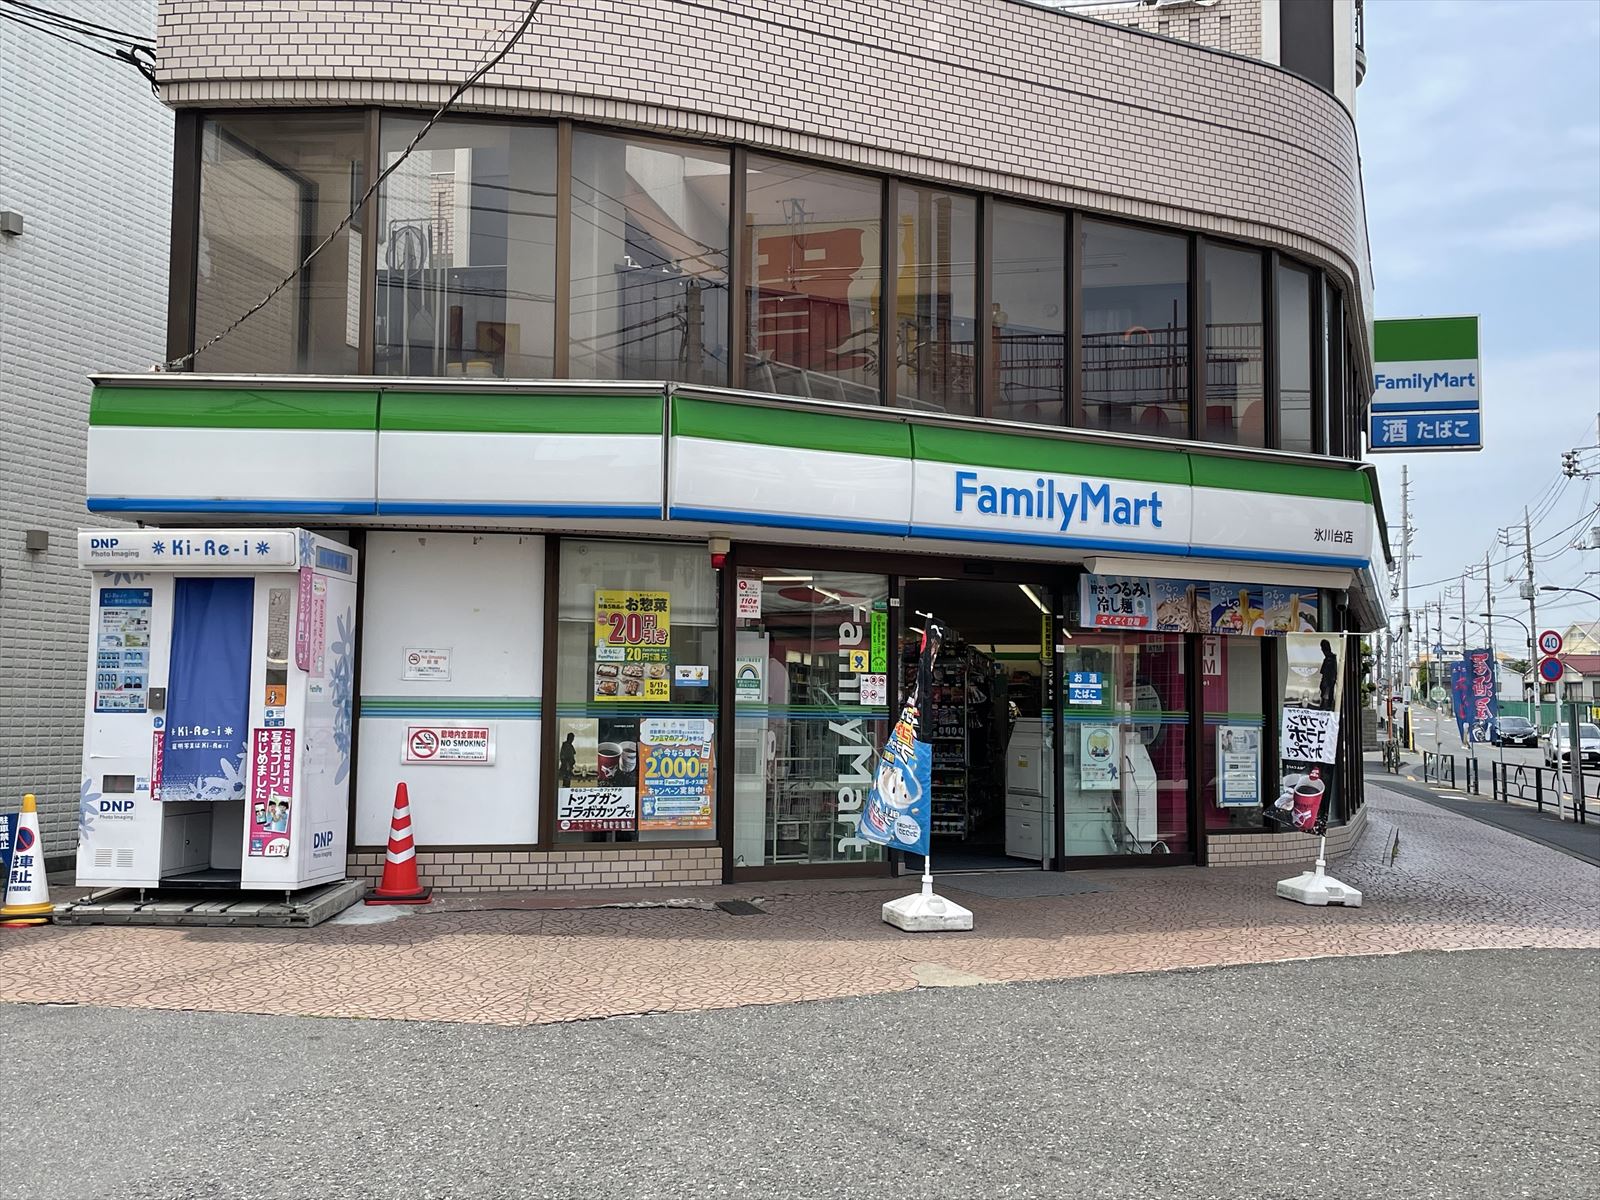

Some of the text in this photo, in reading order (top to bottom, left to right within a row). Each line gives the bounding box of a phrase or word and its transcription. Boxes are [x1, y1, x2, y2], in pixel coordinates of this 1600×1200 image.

[1375, 372, 1475, 392] FamilyMart
[1382, 419, 1470, 442] 酒 たばこ
[955, 471, 1162, 531] FamilyMart
[1314, 528, 1353, 543] 氷川台店
[91, 538, 118, 549] DNP
[172, 539, 248, 556] Ki-Re-i
[111, 550, 140, 558] Imaging
[625, 597, 667, 612] お惣菜
[1097, 596, 1133, 613] 冷し麺
[609, 613, 656, 644] 20 円
[643, 629, 667, 643] 引き
[1544, 637, 1557, 649] 40
[626, 647, 642, 661] 20
[1074, 673, 1097, 683] お酒
[1074, 689, 1097, 699] たばこ
[178, 726, 221, 736] Ki-Re-i
[663, 748, 700, 757] 今なら最大
[256, 731, 269, 799] はじめました
[270, 731, 282, 798] 写真プリント
[645, 757, 700, 778] 2,000
[100, 801, 134, 812] DNP
[568, 793, 622, 806] トップガン
[560, 804, 634, 819] コラボカップで!
[313, 831, 333, 849] DNP
